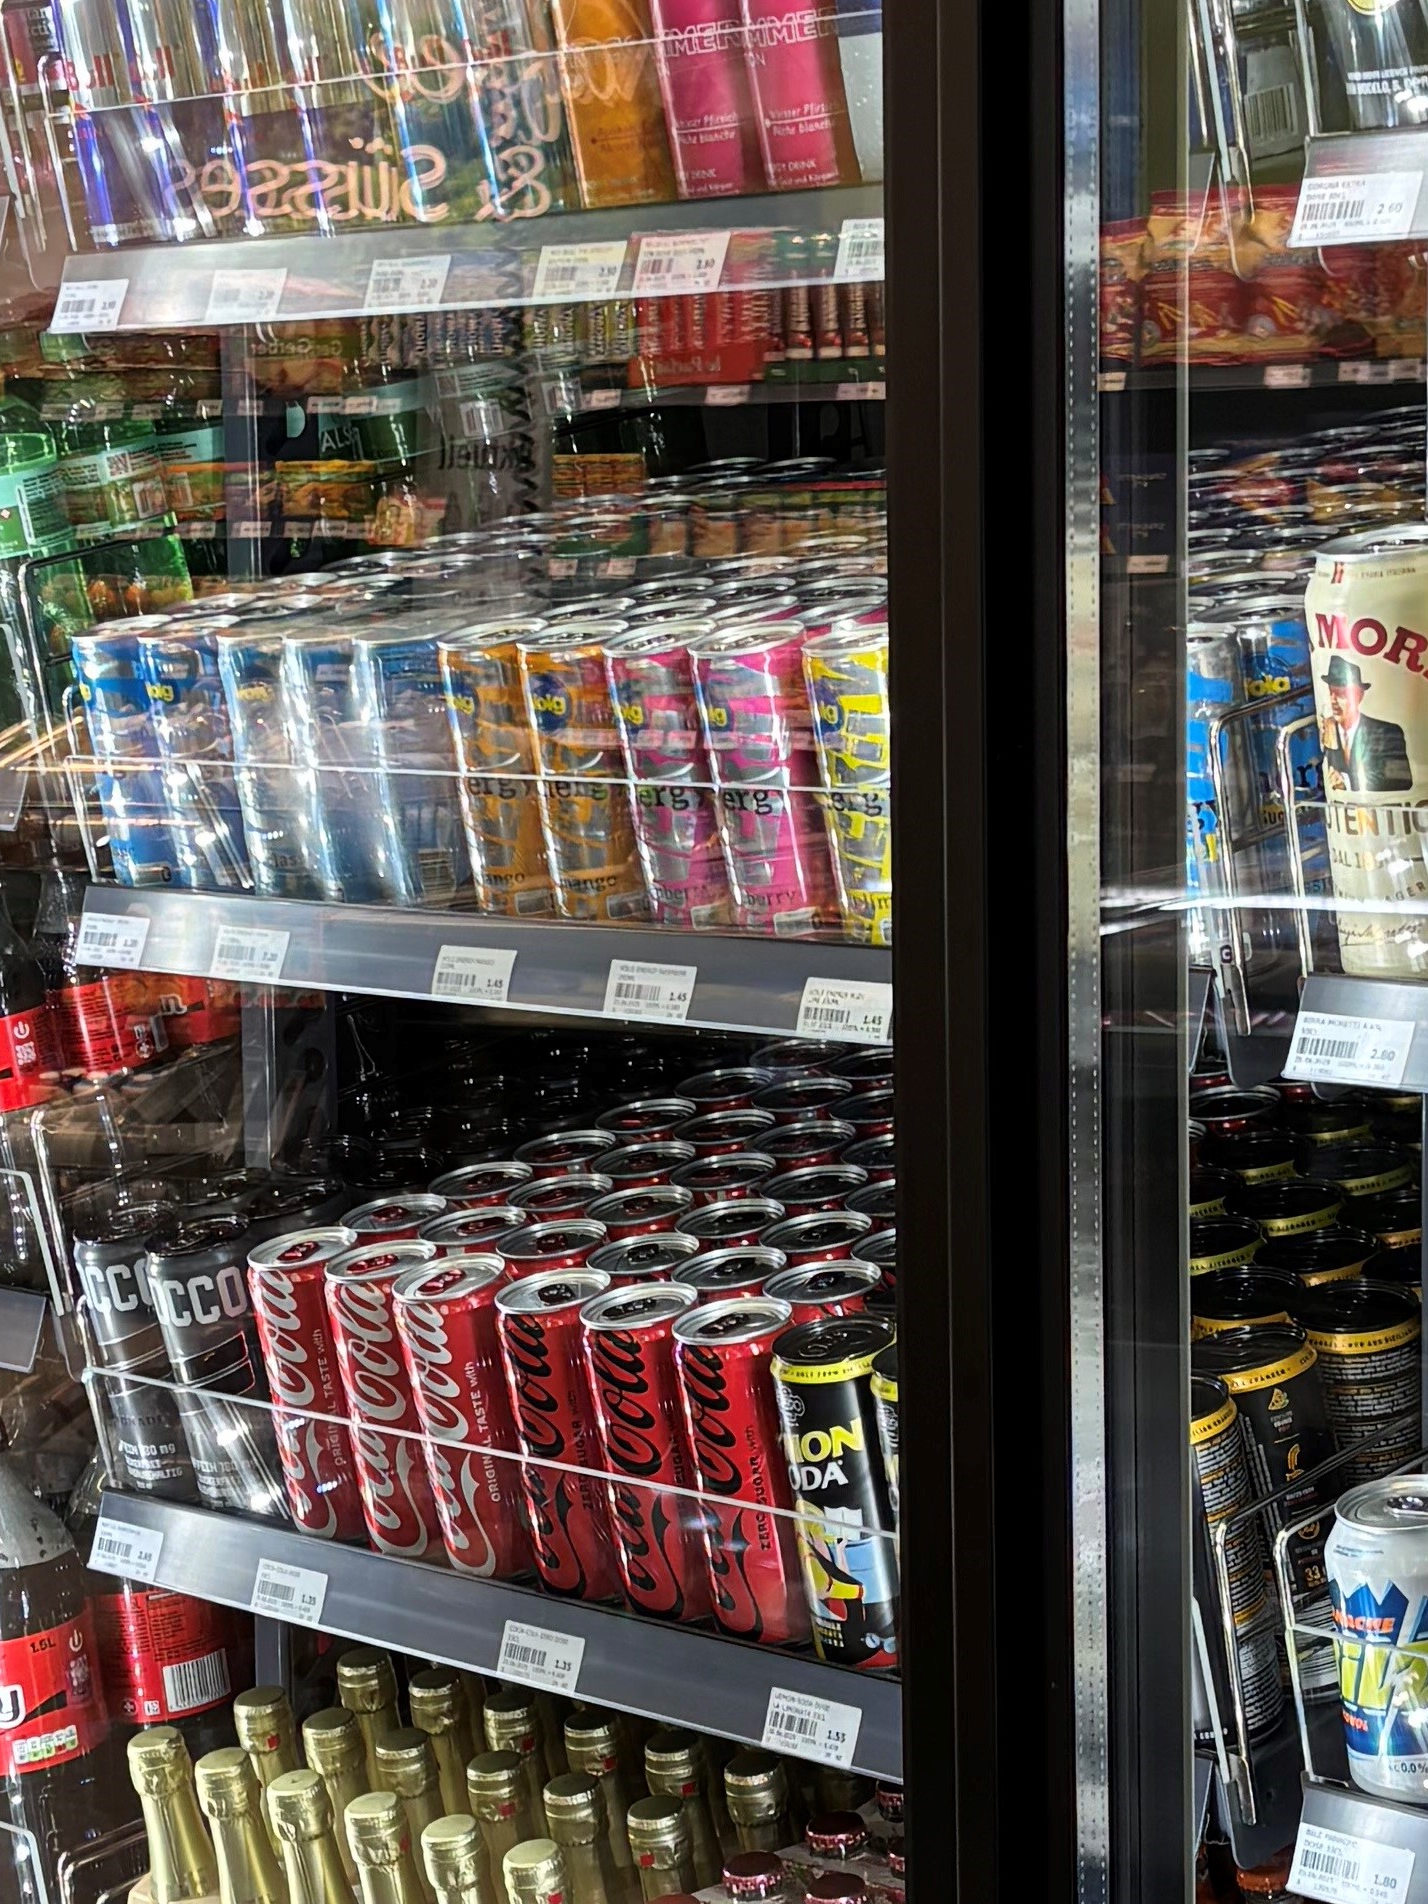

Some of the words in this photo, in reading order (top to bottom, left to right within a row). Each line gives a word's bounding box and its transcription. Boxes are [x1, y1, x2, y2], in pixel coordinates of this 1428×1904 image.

[669, 991, 687, 1002] 1.45
[863, 1014, 882, 1026] 1.45
[1373, 1873, 1397, 1891] 1.80
